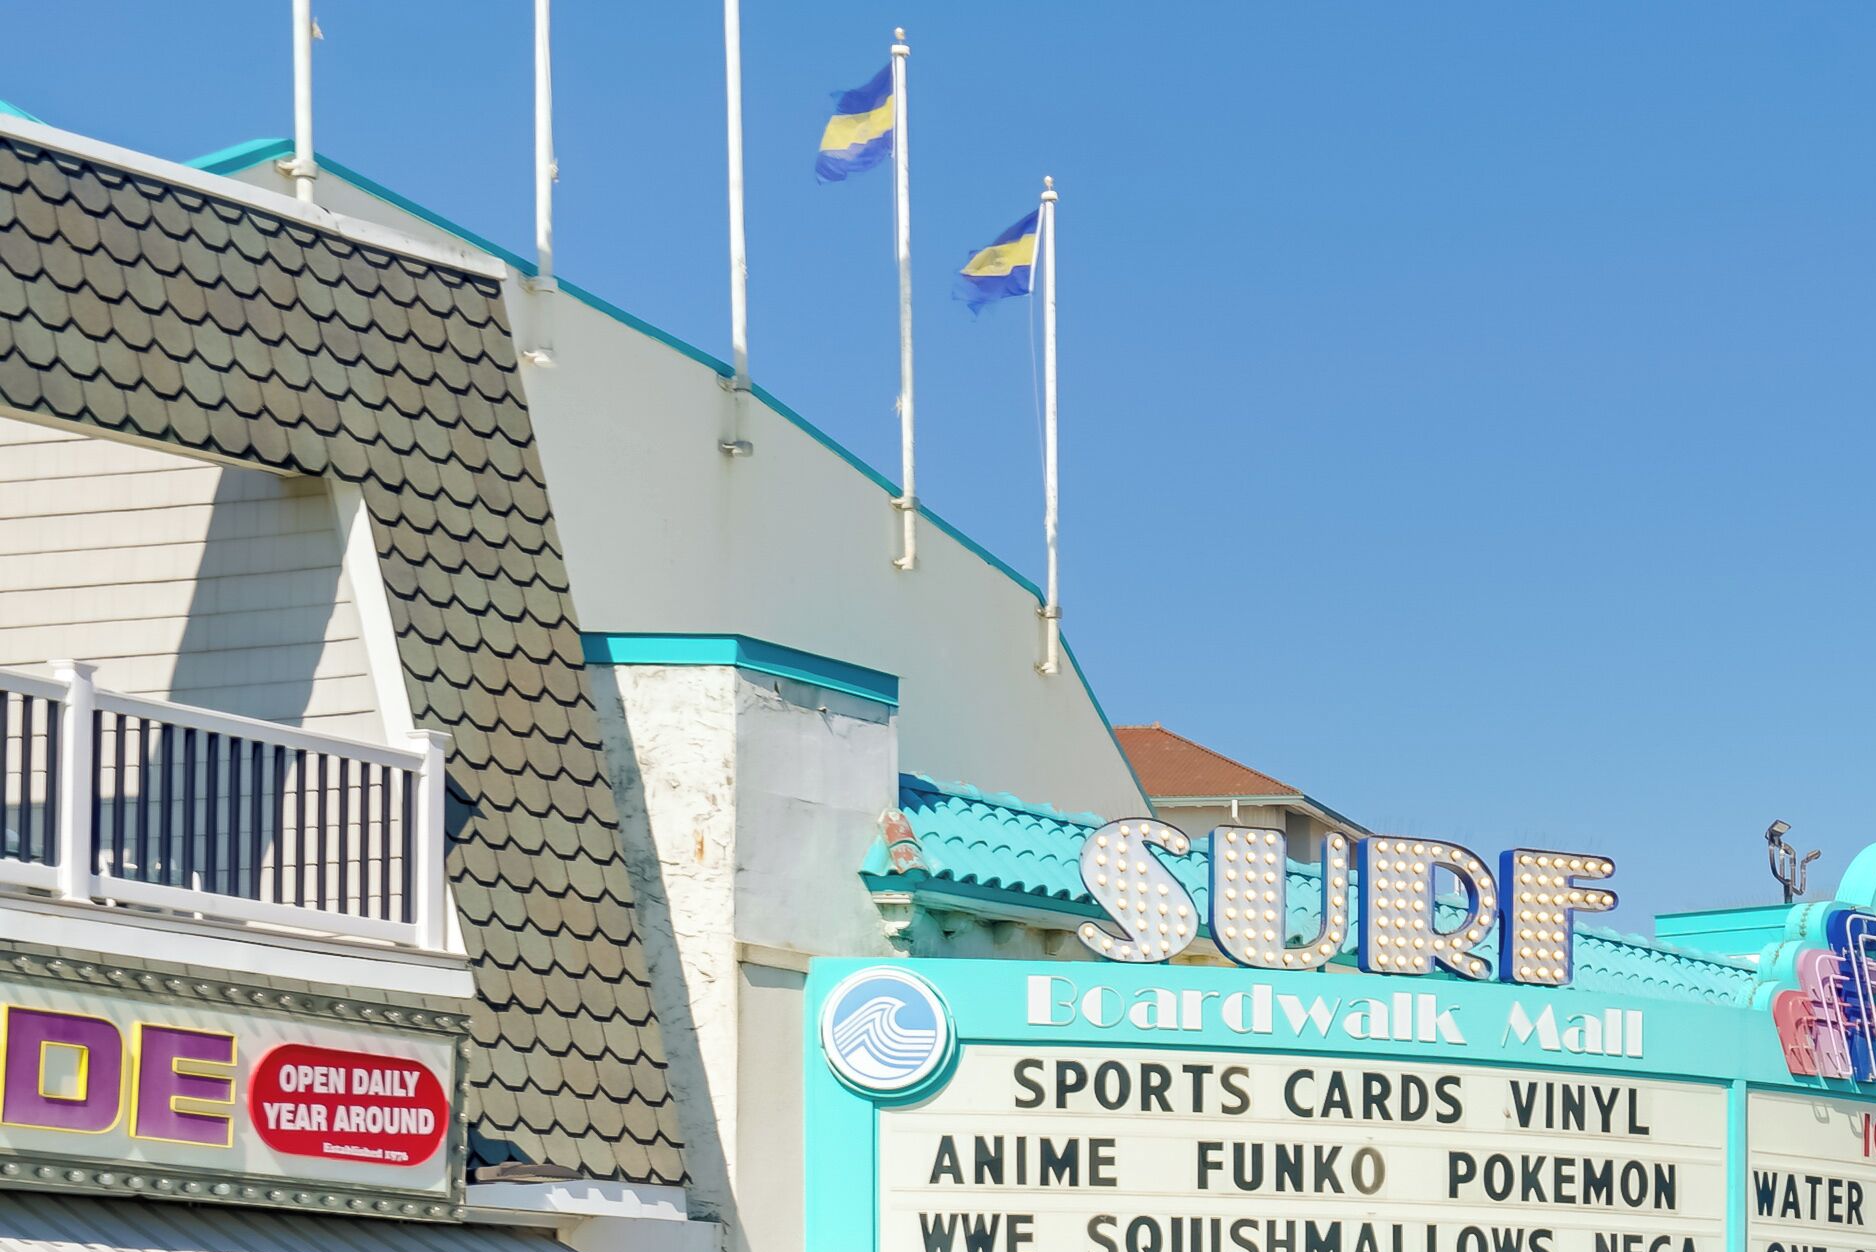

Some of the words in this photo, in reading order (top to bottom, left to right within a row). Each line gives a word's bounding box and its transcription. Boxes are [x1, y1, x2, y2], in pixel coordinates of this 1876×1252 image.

[1077, 816, 1619, 985] SURF
[1026, 974, 1468, 1045] Boardwalk
[1500, 1001, 1643, 1059] Mall
[262, 1102, 329, 1132] YEAR
[333, 1105, 435, 1135] AROUND
[279, 1064, 345, 1096] OPEN
[351, 1068, 420, 1098] DAILY
[1013, 1058, 1252, 1116] SPORTS
[1284, 1067, 1463, 1124] CARDS
[1509, 1080, 1651, 1136] VINYL
[929, 1135, 1118, 1187] ANIME
[1197, 1140, 1386, 1196] FUNKO
[1449, 1151, 1677, 1210] POKEMON
[1754, 1171, 1864, 1225] WATER
